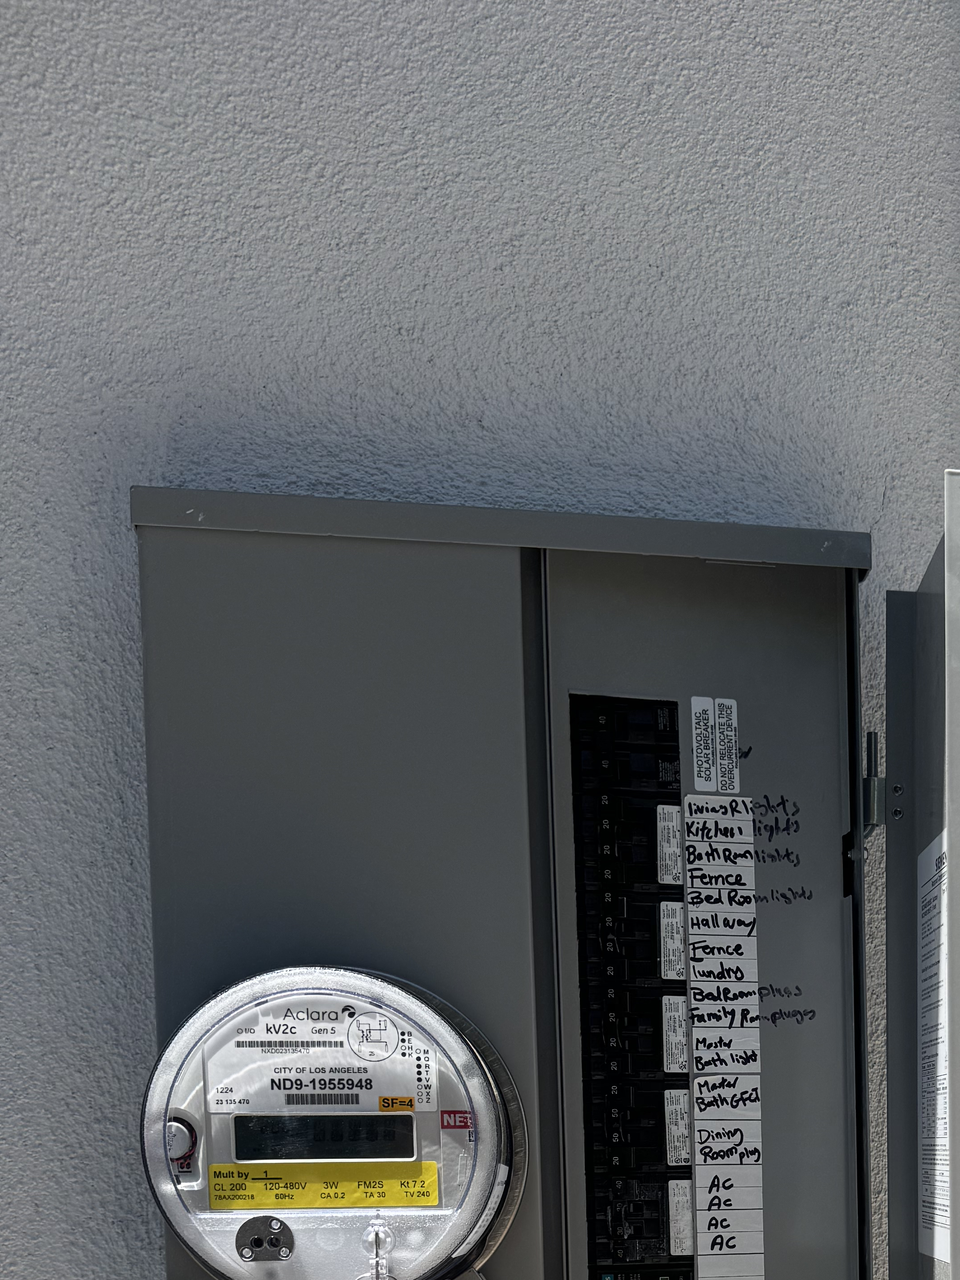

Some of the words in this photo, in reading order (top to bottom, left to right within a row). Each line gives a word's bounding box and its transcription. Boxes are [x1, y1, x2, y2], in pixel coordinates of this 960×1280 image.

[702, 709, 711, 751] BREAKER
[695, 712, 704, 779] PHOTOVOLTAIC
[704, 754, 712, 782] SOLAR
[283, 1008, 338, 1021] Aclara
[266, 1024, 297, 1035] kV2c
[271, 1079, 373, 1090] ND9-1955948
[382, 1098, 414, 1108] SF=4
[238, 1171, 249, 1180] by
[230, 1183, 246, 1191] 200
[264, 1182, 307, 1190] 120-480V
[708, 1175, 733, 1194] AC
[708, 1217, 730, 1230] AC
[711, 1235, 736, 1251] AC
